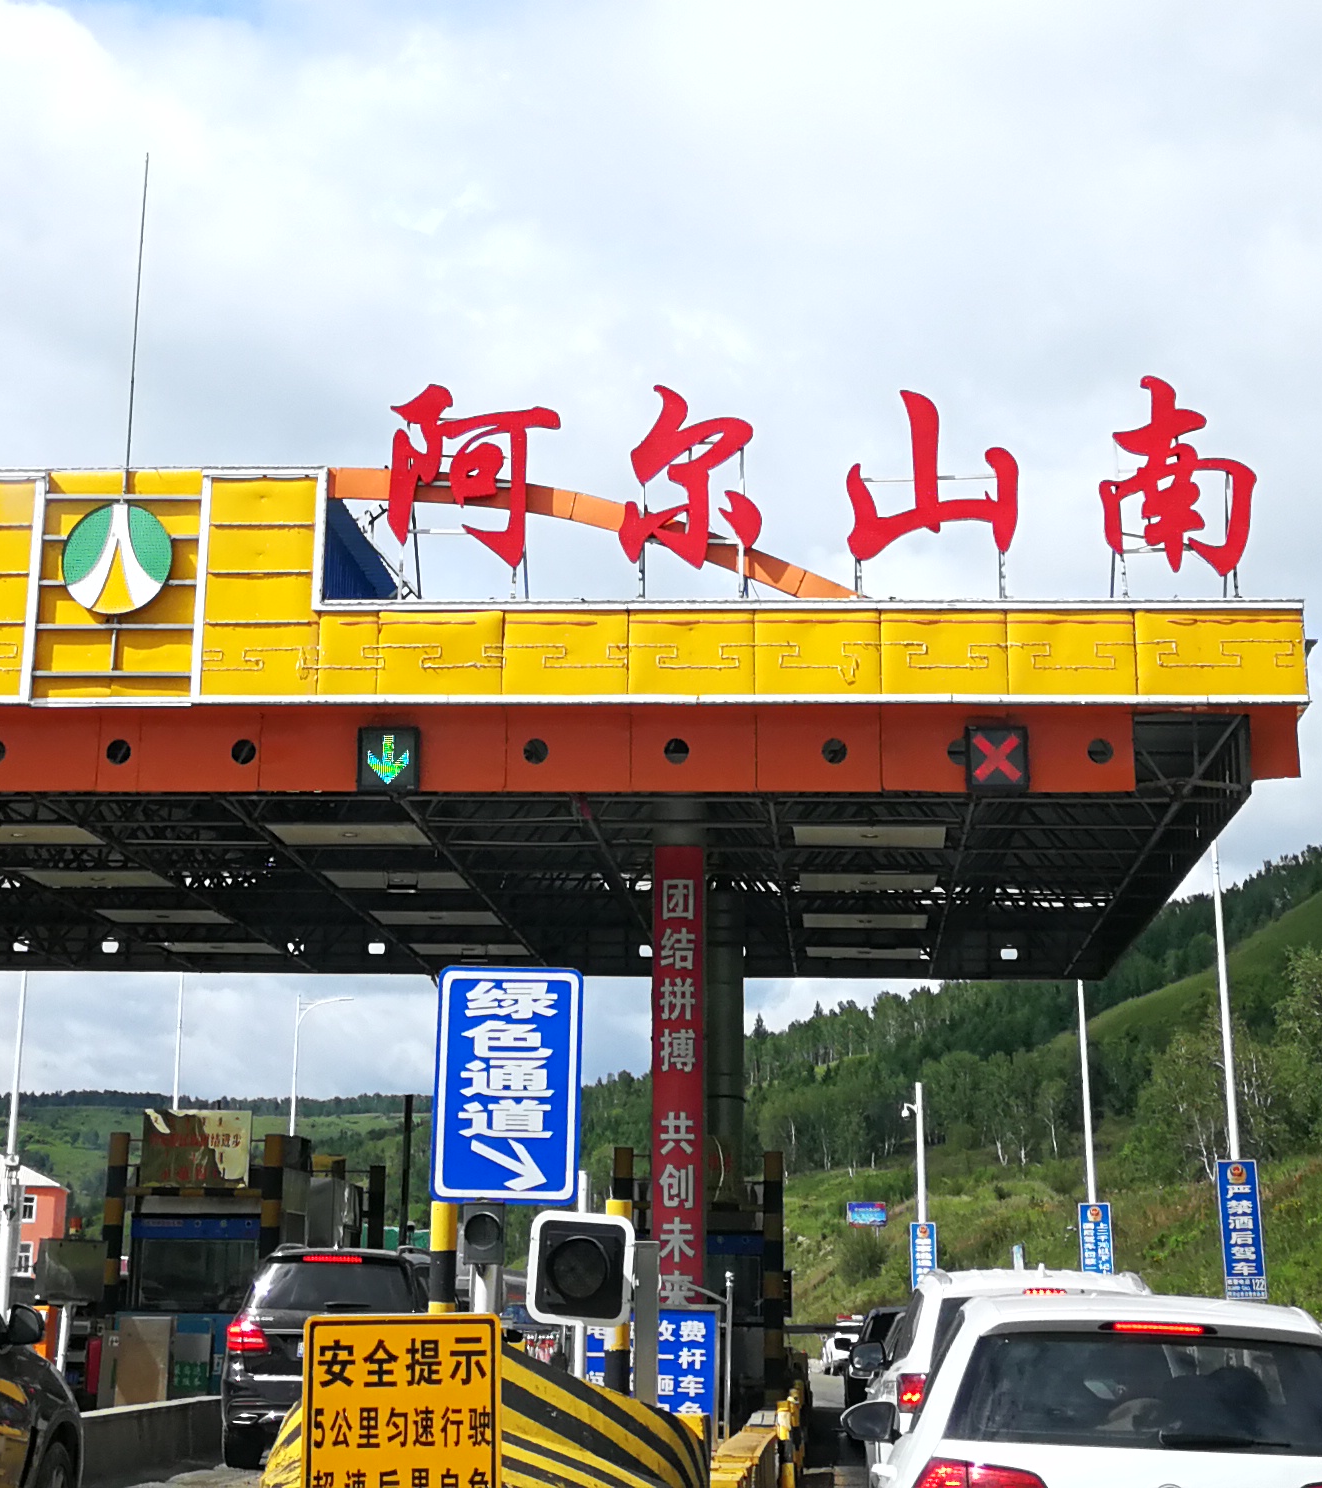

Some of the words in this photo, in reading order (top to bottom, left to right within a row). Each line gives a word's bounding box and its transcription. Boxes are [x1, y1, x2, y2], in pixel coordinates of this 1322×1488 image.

[390, 375, 1257, 578] 阿尔山南
[659, 878, 696, 1073] 团结拼搏
[457, 980, 559, 1140] 绿色通道
[658, 1111, 697, 1305] 共创未来
[1225, 1184, 1259, 1277] 严禁酒后驾车
[1251, 1278, 1266, 1291] 122
[318, 1337, 488, 1388] 安全提示
[313, 1406, 492, 1449] 5公里匀速行驶
